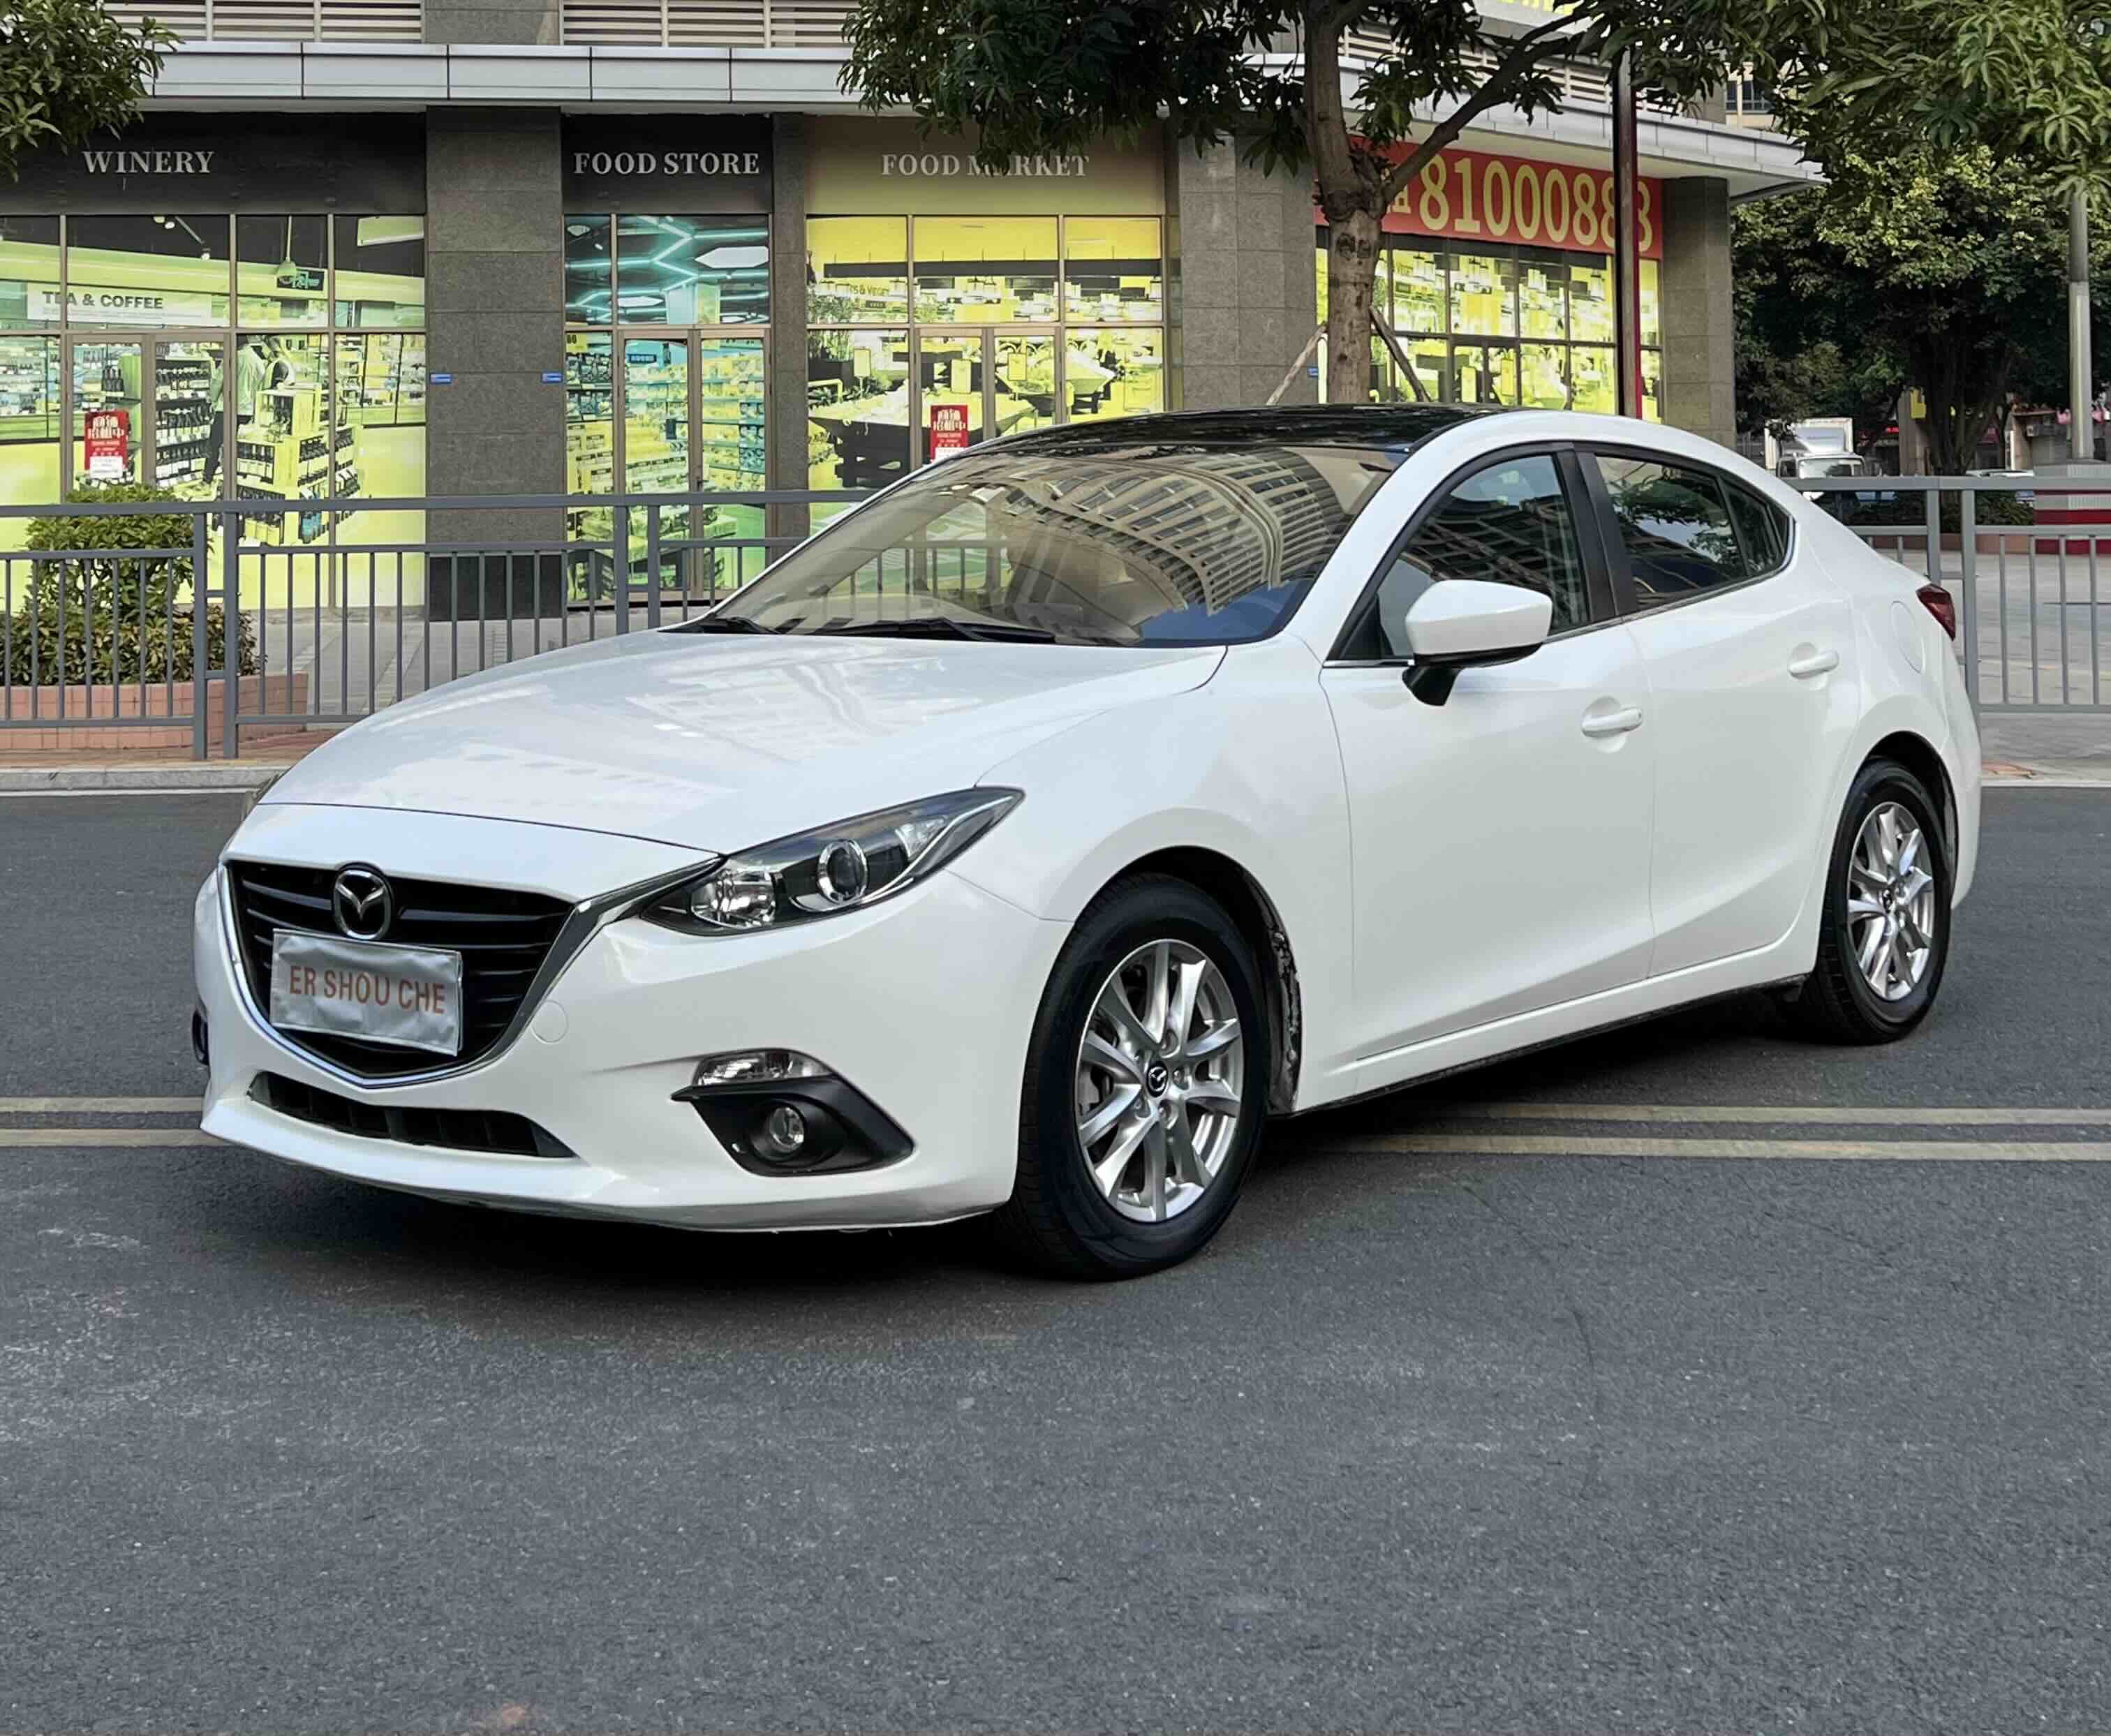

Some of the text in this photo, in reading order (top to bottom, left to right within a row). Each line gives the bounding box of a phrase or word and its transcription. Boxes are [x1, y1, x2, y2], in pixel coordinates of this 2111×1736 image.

[82, 151, 214, 173] WINERY
[573, 152, 760, 174] FOOD STORE
[882, 154, 960, 175] FOOD
[82, 293, 95, 306] &
[100, 294, 163, 309] COFFEE
[290, 966, 445, 1014] ER SHOU CHE
